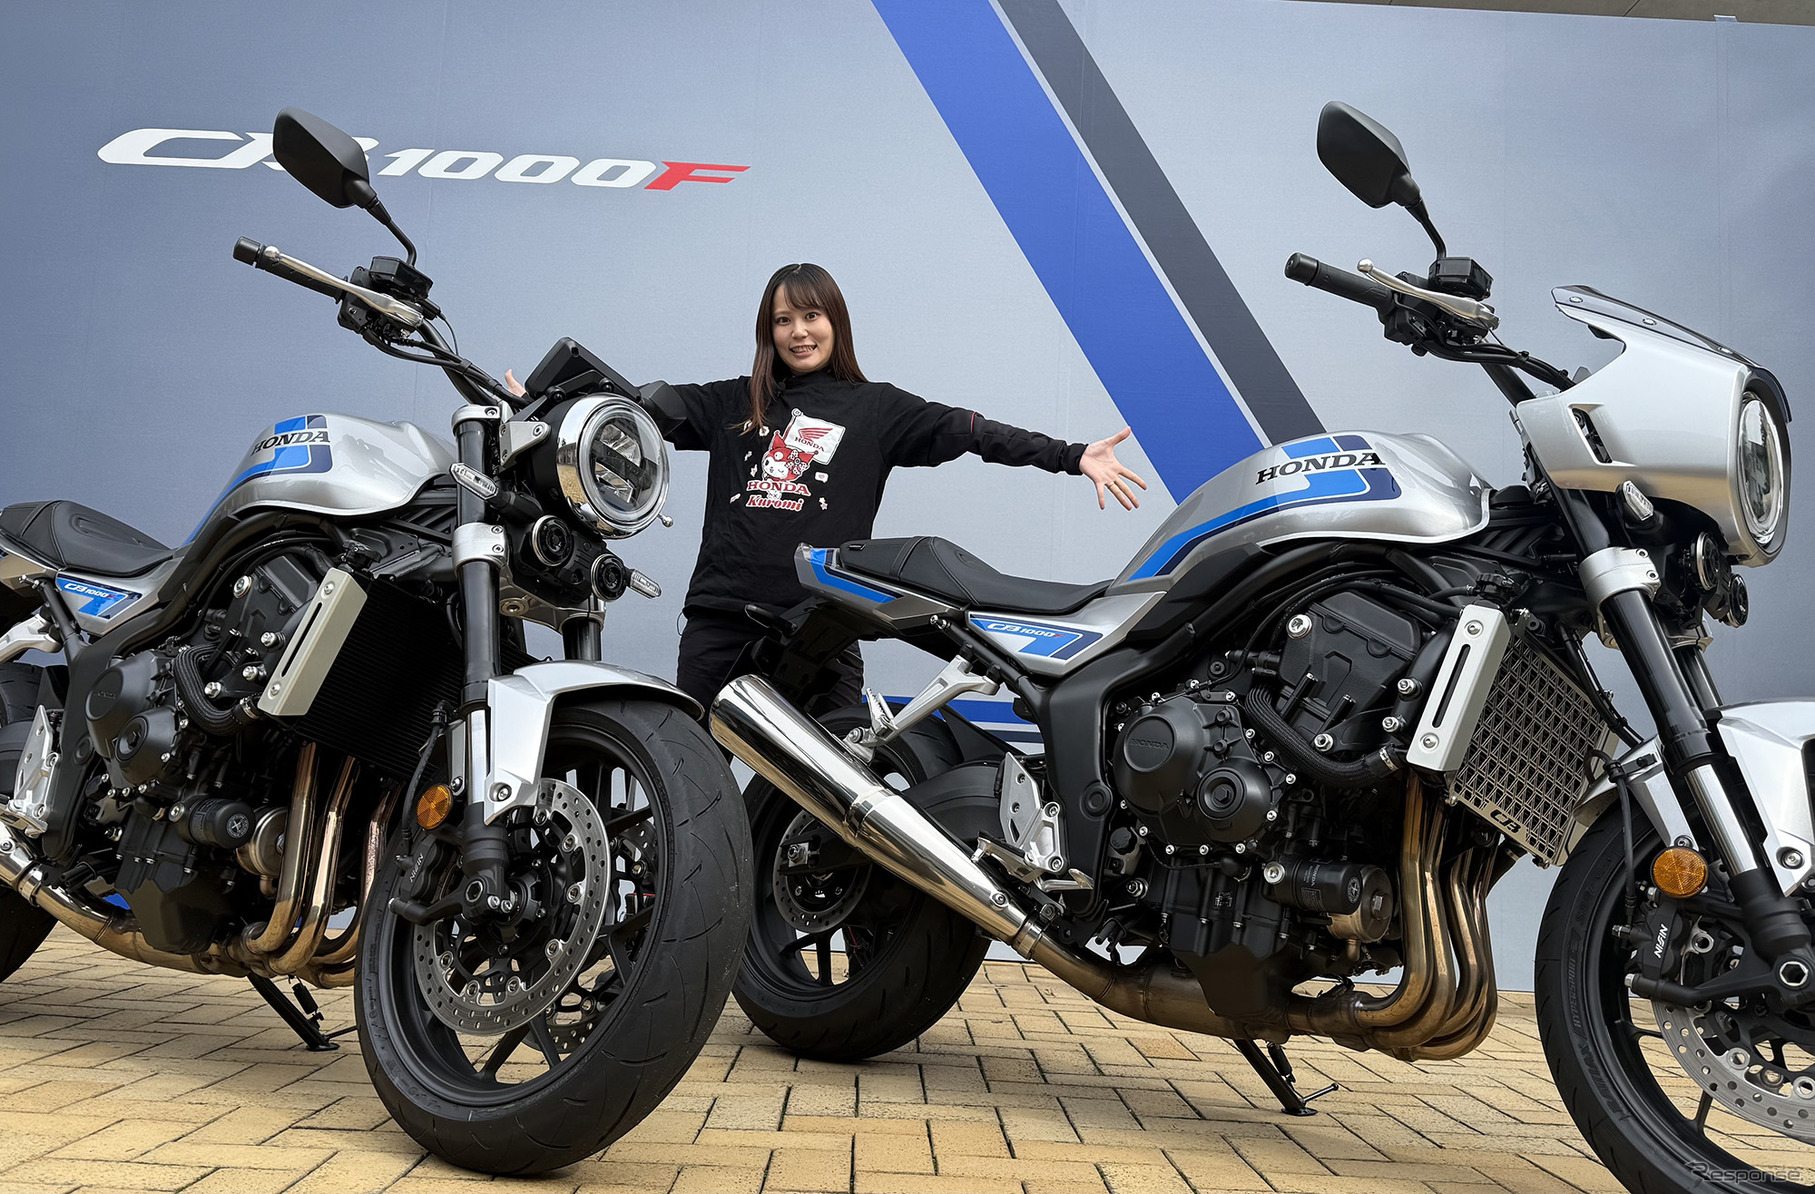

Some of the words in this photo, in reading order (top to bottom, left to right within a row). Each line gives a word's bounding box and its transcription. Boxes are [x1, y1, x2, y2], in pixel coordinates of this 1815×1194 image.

[98, 127, 750, 191] C1000F
[250, 430, 330, 457] HONDA
[794, 436, 825, 452] HONDA
[1255, 452, 1386, 485] HONDA
[746, 480, 811, 496] HONDA
[746, 494, 805, 512] Kuromi
[987, 622, 1065, 638] CB1000F
[1490, 809, 1521, 833] CB
[1653, 923, 1668, 958] NISSIN
